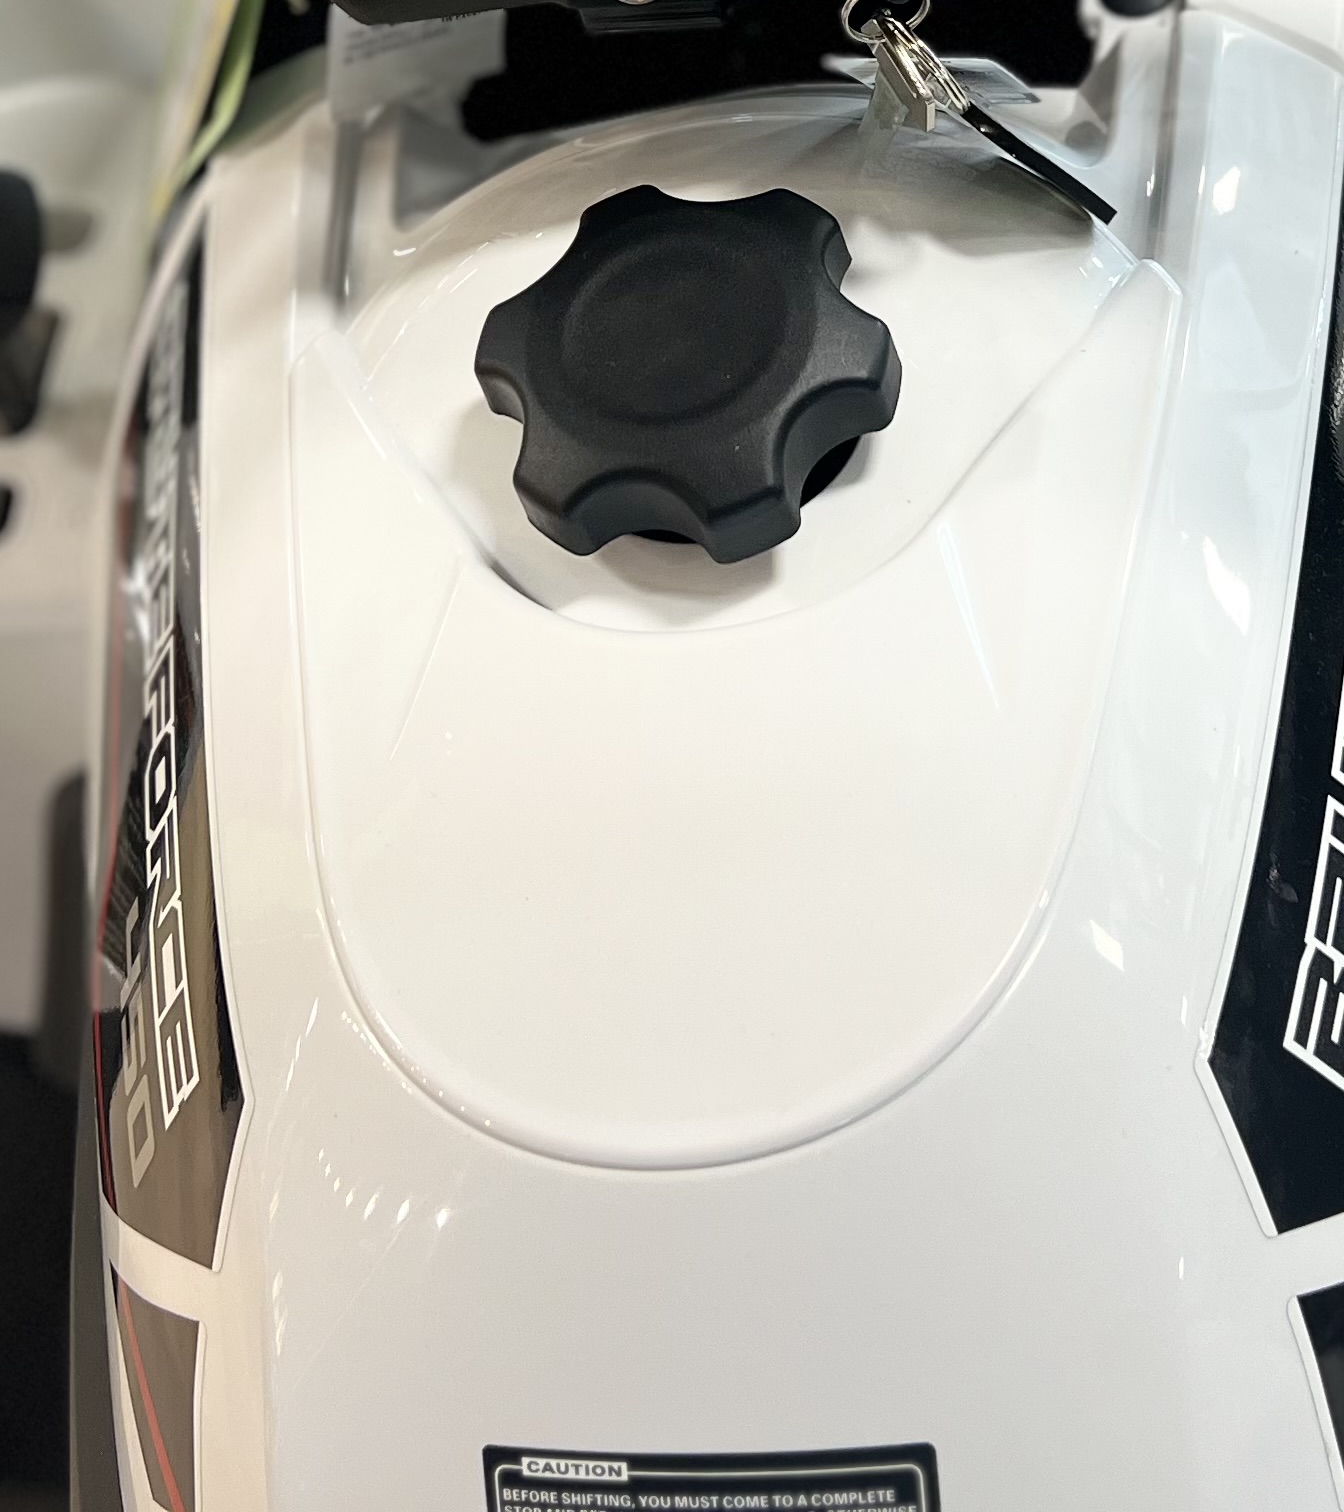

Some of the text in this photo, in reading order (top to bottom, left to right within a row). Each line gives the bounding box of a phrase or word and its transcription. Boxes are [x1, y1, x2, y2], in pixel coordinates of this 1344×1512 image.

[120, 893, 156, 1189] 450
[527, 1460, 622, 1477] CAUTION
[503, 1488, 895, 1509] BEFORE SHIFTING, YOU MUST COME TO A COMPLETE
